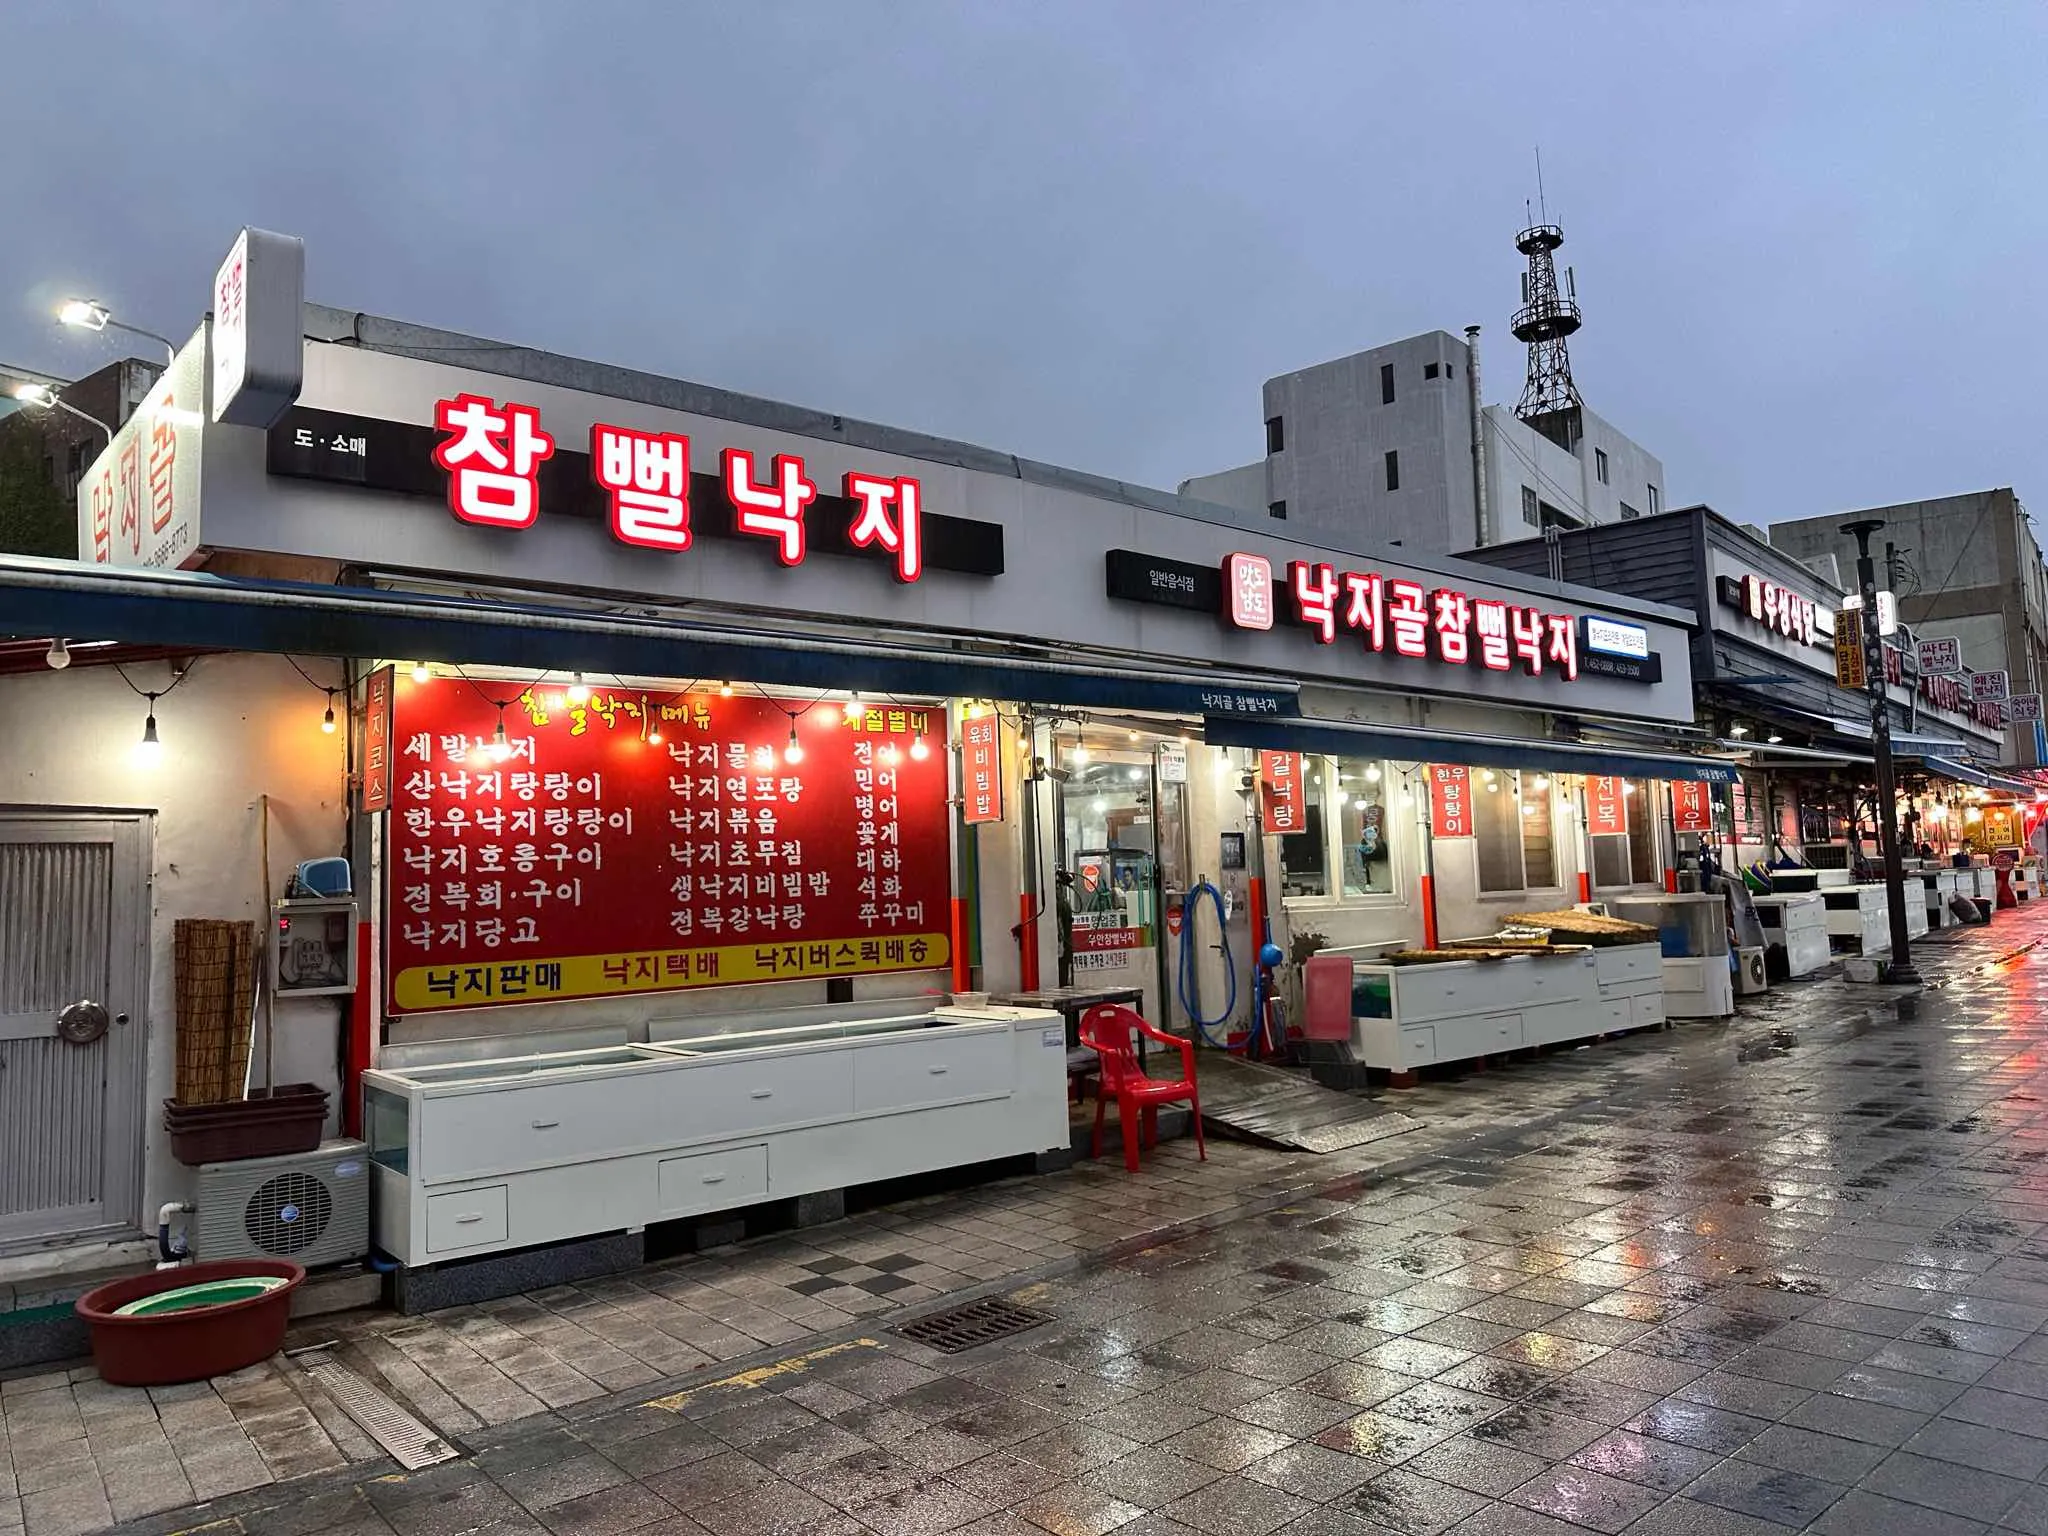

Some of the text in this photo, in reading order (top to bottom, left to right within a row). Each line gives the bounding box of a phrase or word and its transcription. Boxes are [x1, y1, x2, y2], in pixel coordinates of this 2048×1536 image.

[433, 393, 922, 584] 참뻘낙지
[1150, 570, 1194, 592] 일반음식점
[1288, 561, 1578, 681] 낙지골참뻘낙지
[660, 702, 711, 730] 메뉴
[1201, 692, 1233, 710] 낙지골
[368, 682, 386, 801] 낙지코스
[403, 769, 601, 801] 산낙지탕탕이
[668, 775, 803, 803] 낙지연포탕
[854, 768, 897, 796] 민어
[1271, 754, 1295, 828] 갈낙탕
[854, 795, 898, 820] 병어
[1436, 767, 1465, 833] 한우탕탕이
[1597, 775, 1617, 829] 전복
[403, 807, 632, 838] 한우낙지탕탕이
[669, 807, 778, 835] 낙지볶음
[856, 820, 899, 847] 꽃게
[403, 842, 602, 875] 낙지호롱구이
[669, 839, 802, 868] 낙지초무침
[856, 847, 901, 873] 대하
[670, 871, 831, 902] 생낙지비빔밥
[857, 874, 902, 900] 석화
[670, 903, 806, 936] 전복갈낙탕
[857, 900, 924, 929] 쭈꾸미
[403, 917, 541, 952] 낙지당고
[427, 938, 929, 999] 낙지판매 낙지택배 낙지버스퀵배송
